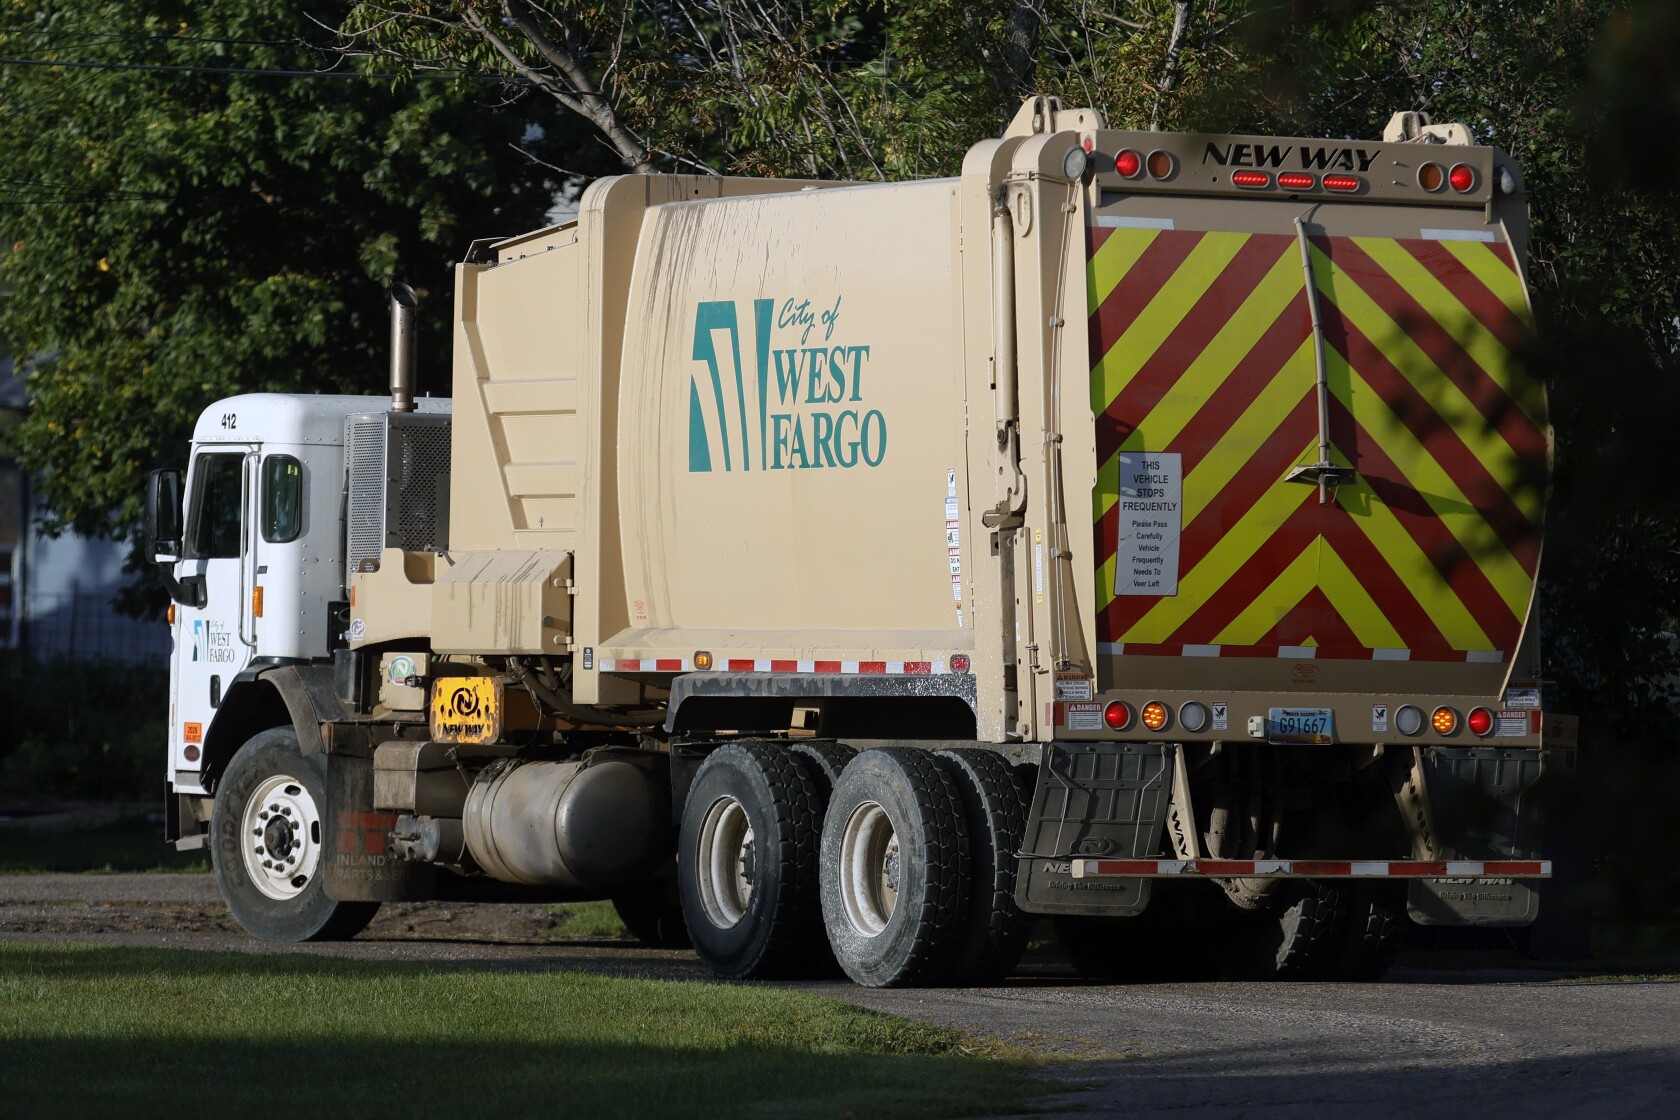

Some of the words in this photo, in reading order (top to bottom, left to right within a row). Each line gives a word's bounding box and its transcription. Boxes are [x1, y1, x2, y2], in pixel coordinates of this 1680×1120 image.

[1202, 142, 1293, 168] NEW
[1300, 146, 1382, 172] WAY
[778, 297, 815, 345] City
[821, 295, 841, 341] of
[772, 345, 870, 406] WEST
[221, 413, 237, 430] 412
[770, 409, 887, 470] FARGO
[1141, 460, 1160, 470] THIS
[1133, 474, 1169, 484] VEHICLE
[1136, 488, 1165, 498] STOPS
[1122, 502, 1178, 512] FREQUENTLY
[1131, 520, 1152, 528] Please
[1153, 520, 1168, 528] Pass
[1136, 532, 1163, 541] Carefully
[1138, 544, 1160, 552] Vehicle
[1132, 556, 1164, 565] Frequently
[1133, 568, 1152, 576] Needs
[1153, 568, 1161, 576] To
[1133, 580, 1147, 588] Veer
[1148, 580, 1160, 588] Left
[210, 632, 231, 646] WEST
[209, 648, 235, 663] FARGO
[443, 723, 463, 735] NEW
[465, 723, 484, 735] WAY
[1280, 717, 1326, 734] G91667
[1172, 810, 1189, 856] WAY
[336, 854, 386, 867] INLAND
[1043, 862, 1073, 874] NE
